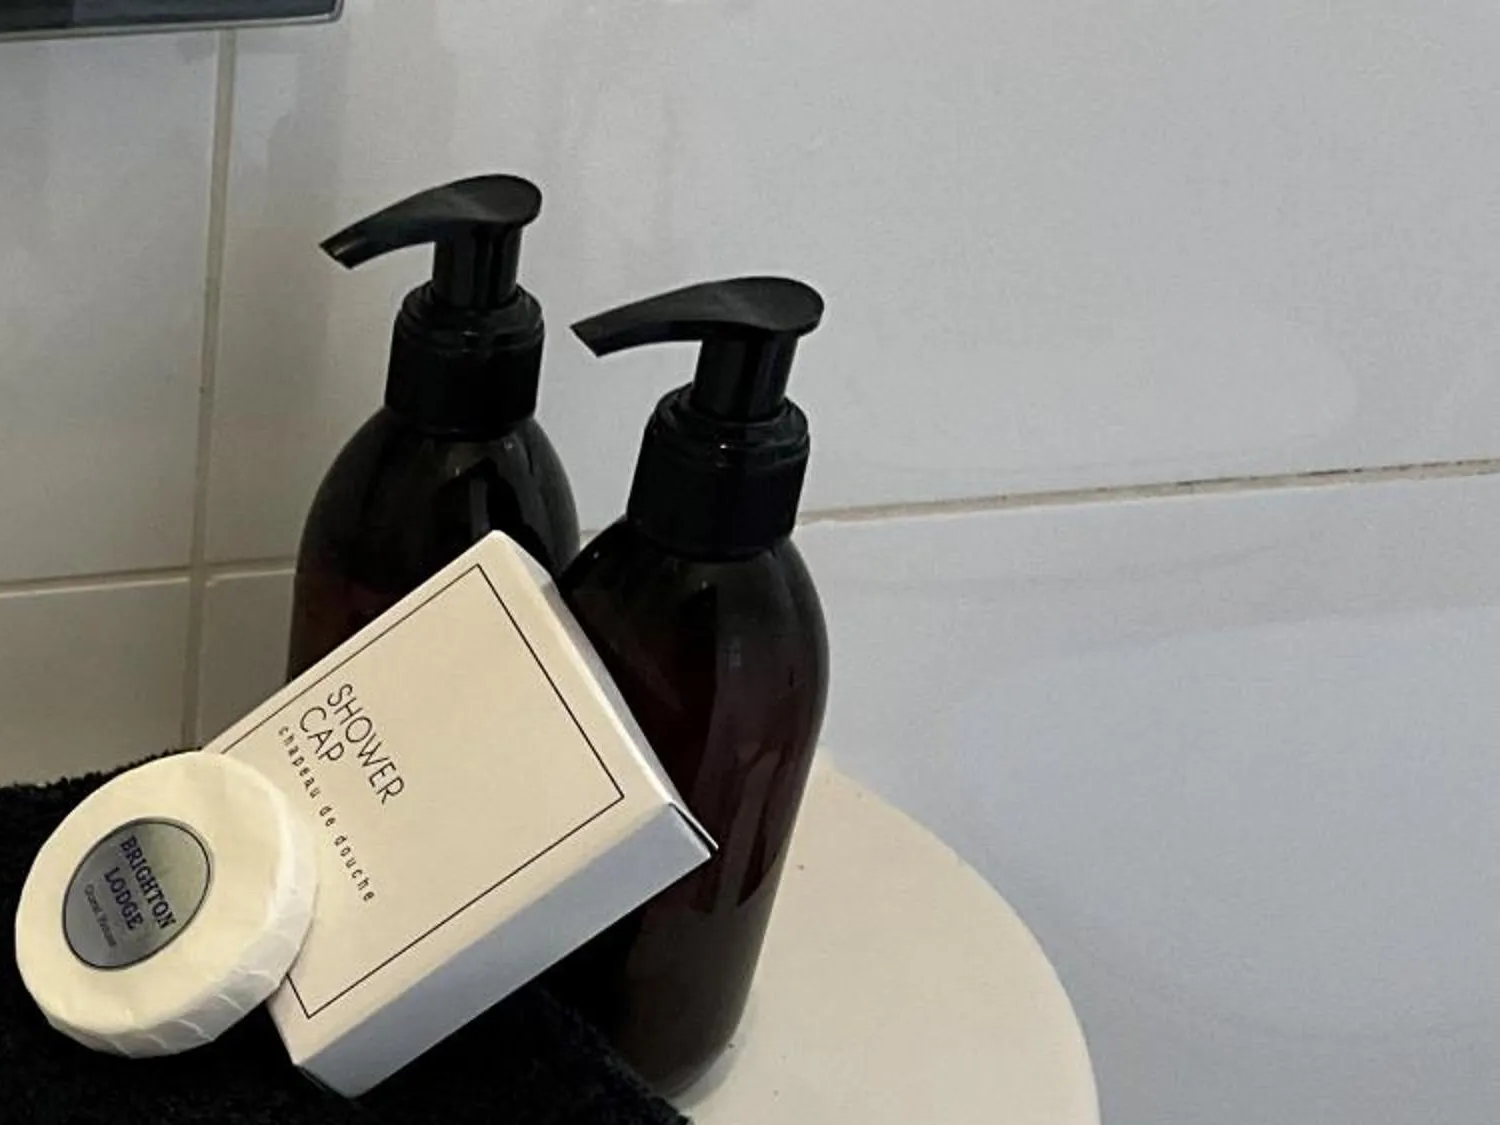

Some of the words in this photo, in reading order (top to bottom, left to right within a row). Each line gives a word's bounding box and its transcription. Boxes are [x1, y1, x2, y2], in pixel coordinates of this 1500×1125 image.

[299, 705, 345, 761] CAP
[327, 683, 405, 805] SHOWER
[278, 725, 322, 799] chapeau
[319, 805, 337, 827] de
[333, 835, 375, 902] douche
[104, 866, 144, 930] LODGE
[120, 834, 177, 929] BRIGHTON
